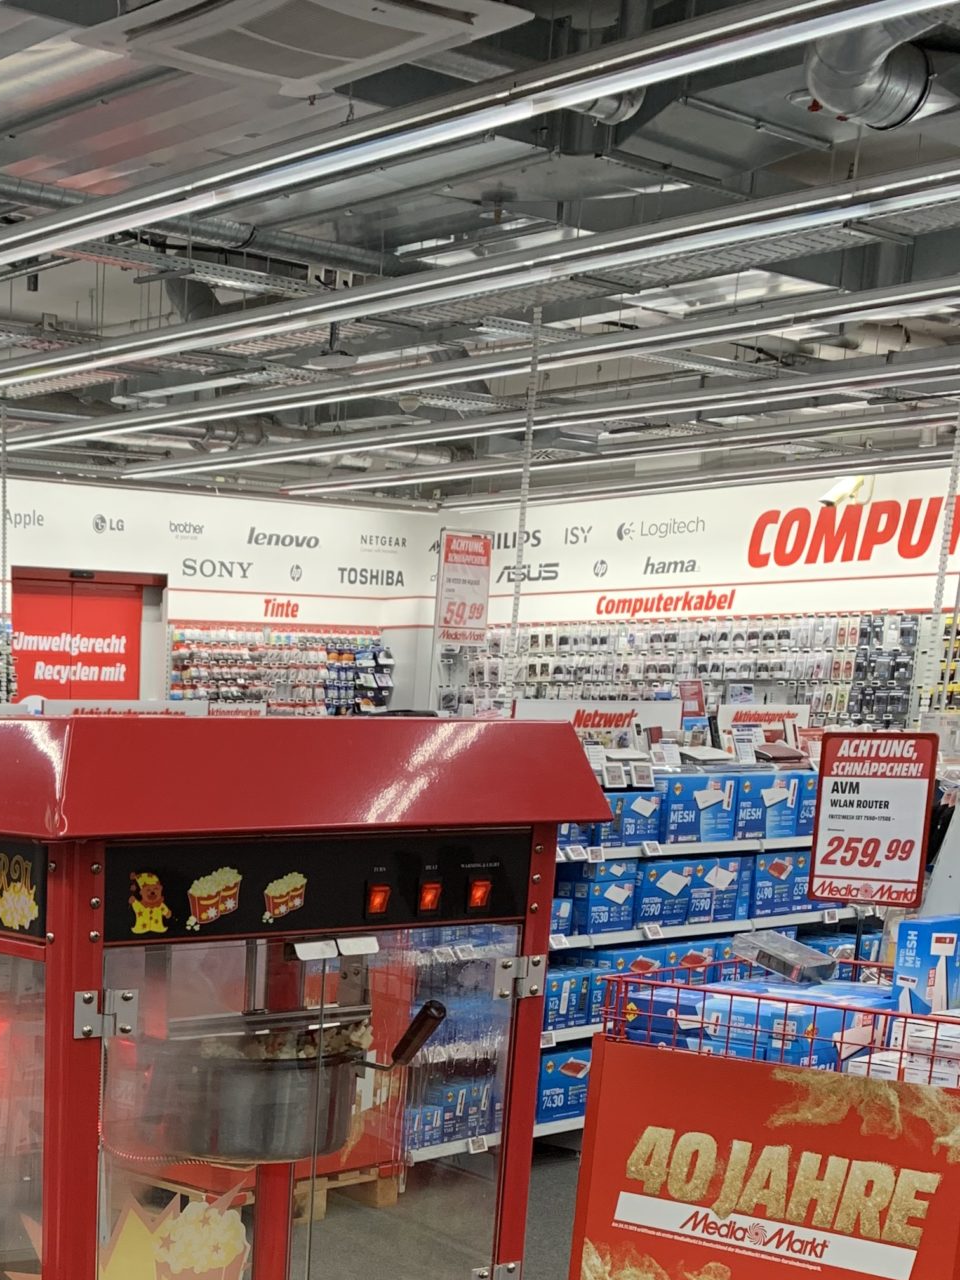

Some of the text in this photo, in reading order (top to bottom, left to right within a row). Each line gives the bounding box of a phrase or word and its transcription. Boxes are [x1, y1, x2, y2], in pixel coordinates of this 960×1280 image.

[5, 509, 44, 528] Apple
[109, 519, 125, 531] LG
[169, 520, 204, 534] brother
[640, 516, 705, 538] Logitech
[247, 526, 319, 549] lenovo
[564, 526, 592, 545] ISY
[747, 492, 960, 568] COMPU
[360, 534, 407, 548] NETGEAR
[182, 558, 253, 579] SONY
[496, 562, 559, 584] ASUS
[643, 556, 696, 575] hama
[338, 566, 404, 587] TOSHIBA
[263, 598, 299, 618] Tinte
[596, 589, 736, 617] Computerkabel
[13, 632, 127, 656] Umweltgerecht
[34, 661, 127, 684] Recyclen mit
[837, 739, 918, 760] ACHTUNG,
[831, 760, 924, 777] SCHNÄPPCHEN!
[831, 781, 860, 794] AVM
[830, 799, 889, 809] WLAN ROUTER
[670, 811, 695, 824] MESH
[739, 808, 762, 820] MESH
[640, 904, 661, 917] 7590
[691, 899, 710, 913] 7590
[591, 912, 608, 924] 7530
[904, 930, 918, 967] MESH
[542, 1094, 564, 1109] 7430
[626, 1126, 942, 1247] 40 JAHRE
[680, 1210, 829, 1258] Media Markt
